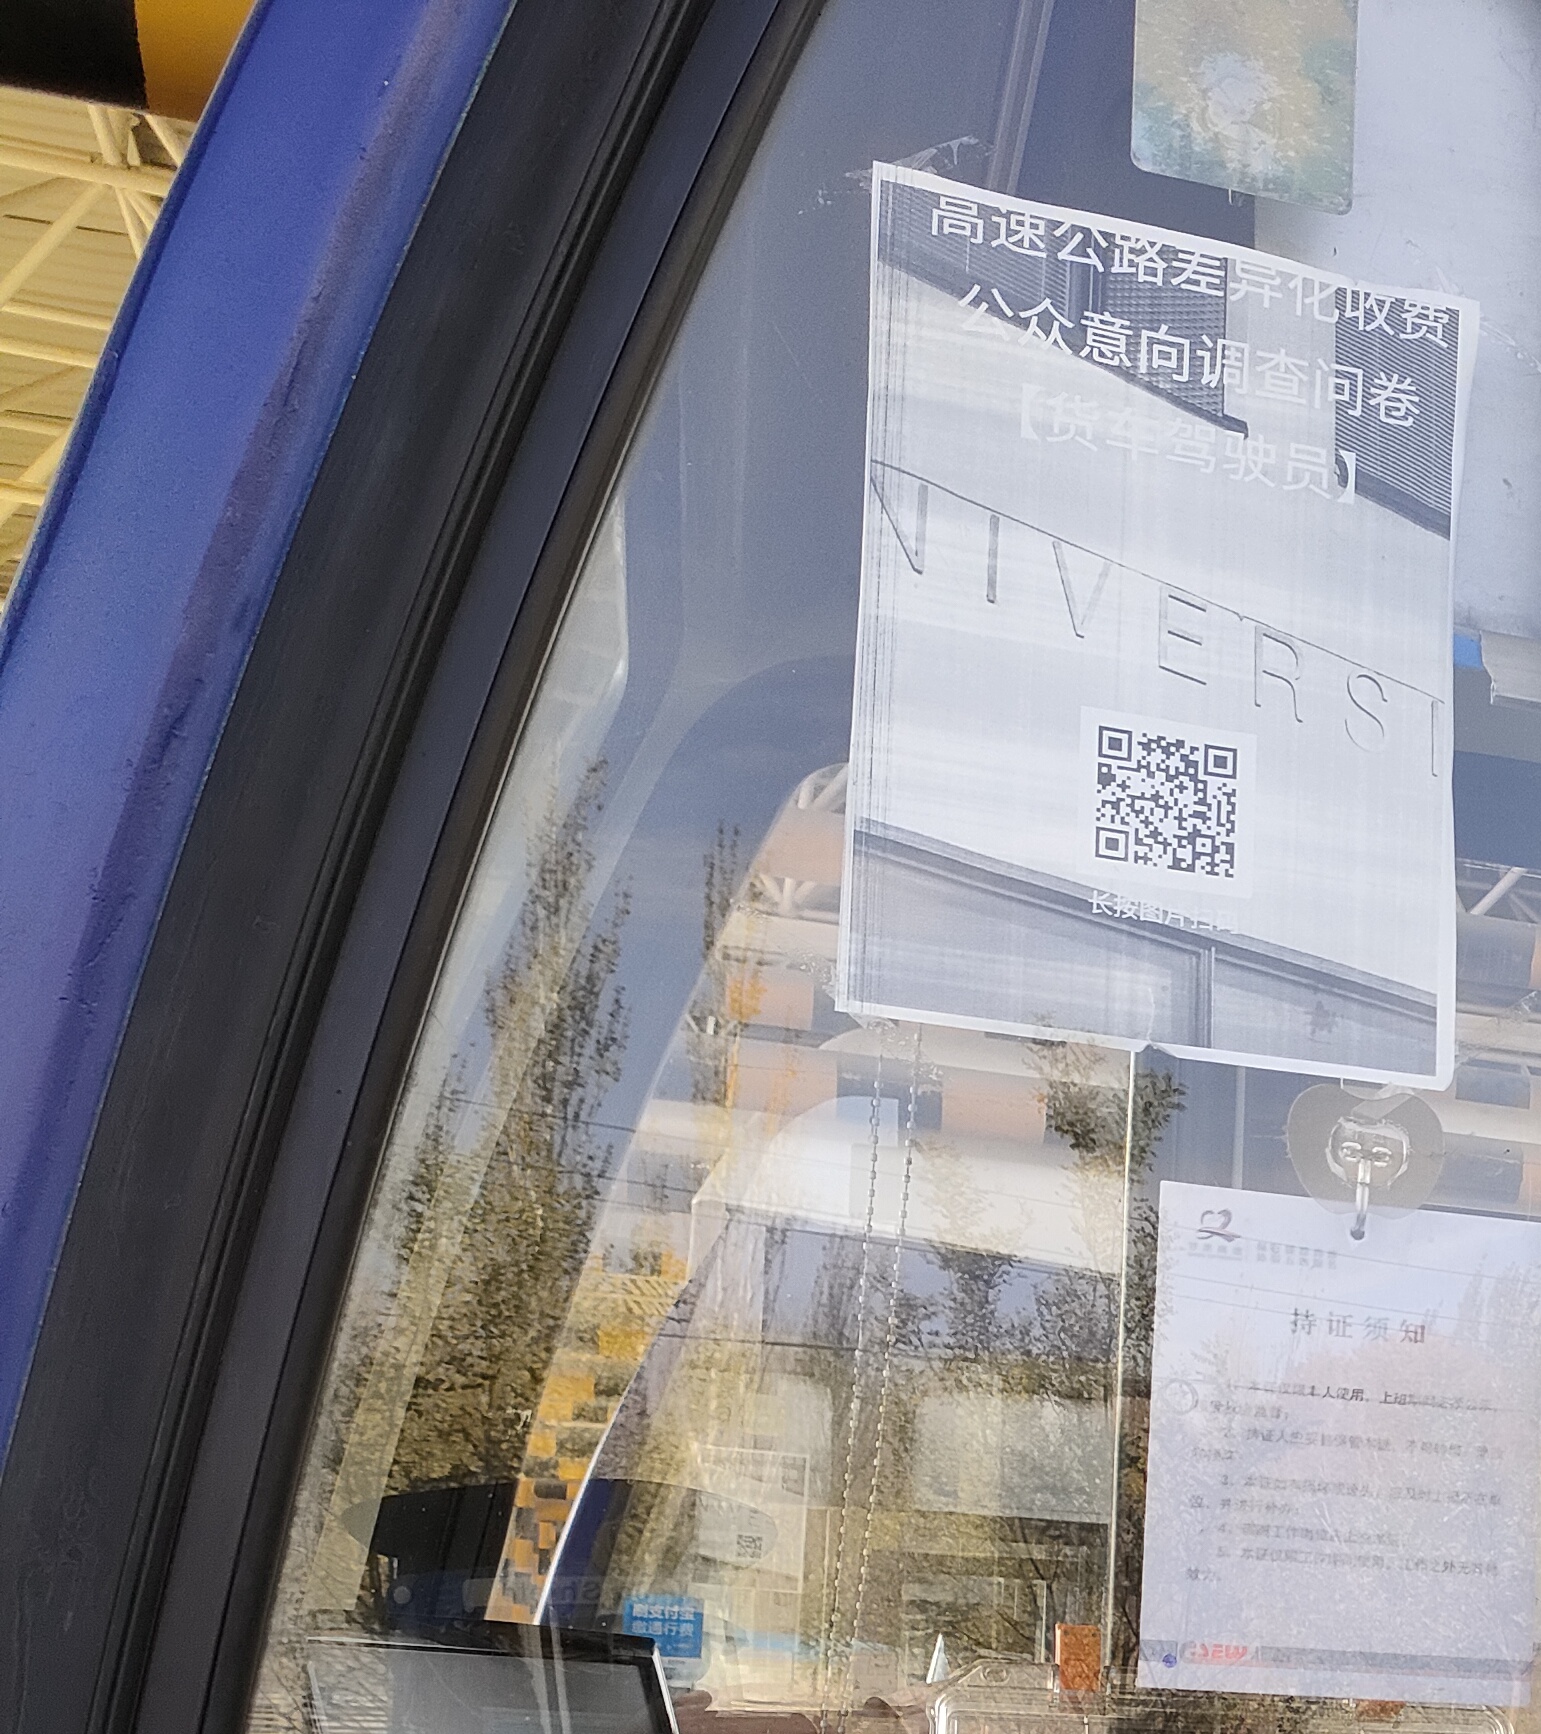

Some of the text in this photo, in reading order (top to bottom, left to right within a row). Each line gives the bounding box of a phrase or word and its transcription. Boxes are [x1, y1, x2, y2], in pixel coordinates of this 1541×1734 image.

[929, 193, 1452, 350] 高速公路差异化收费
[955, 281, 1421, 428] 公众意向调查问卷
[1290, 1307, 1426, 1345] 持证须知
